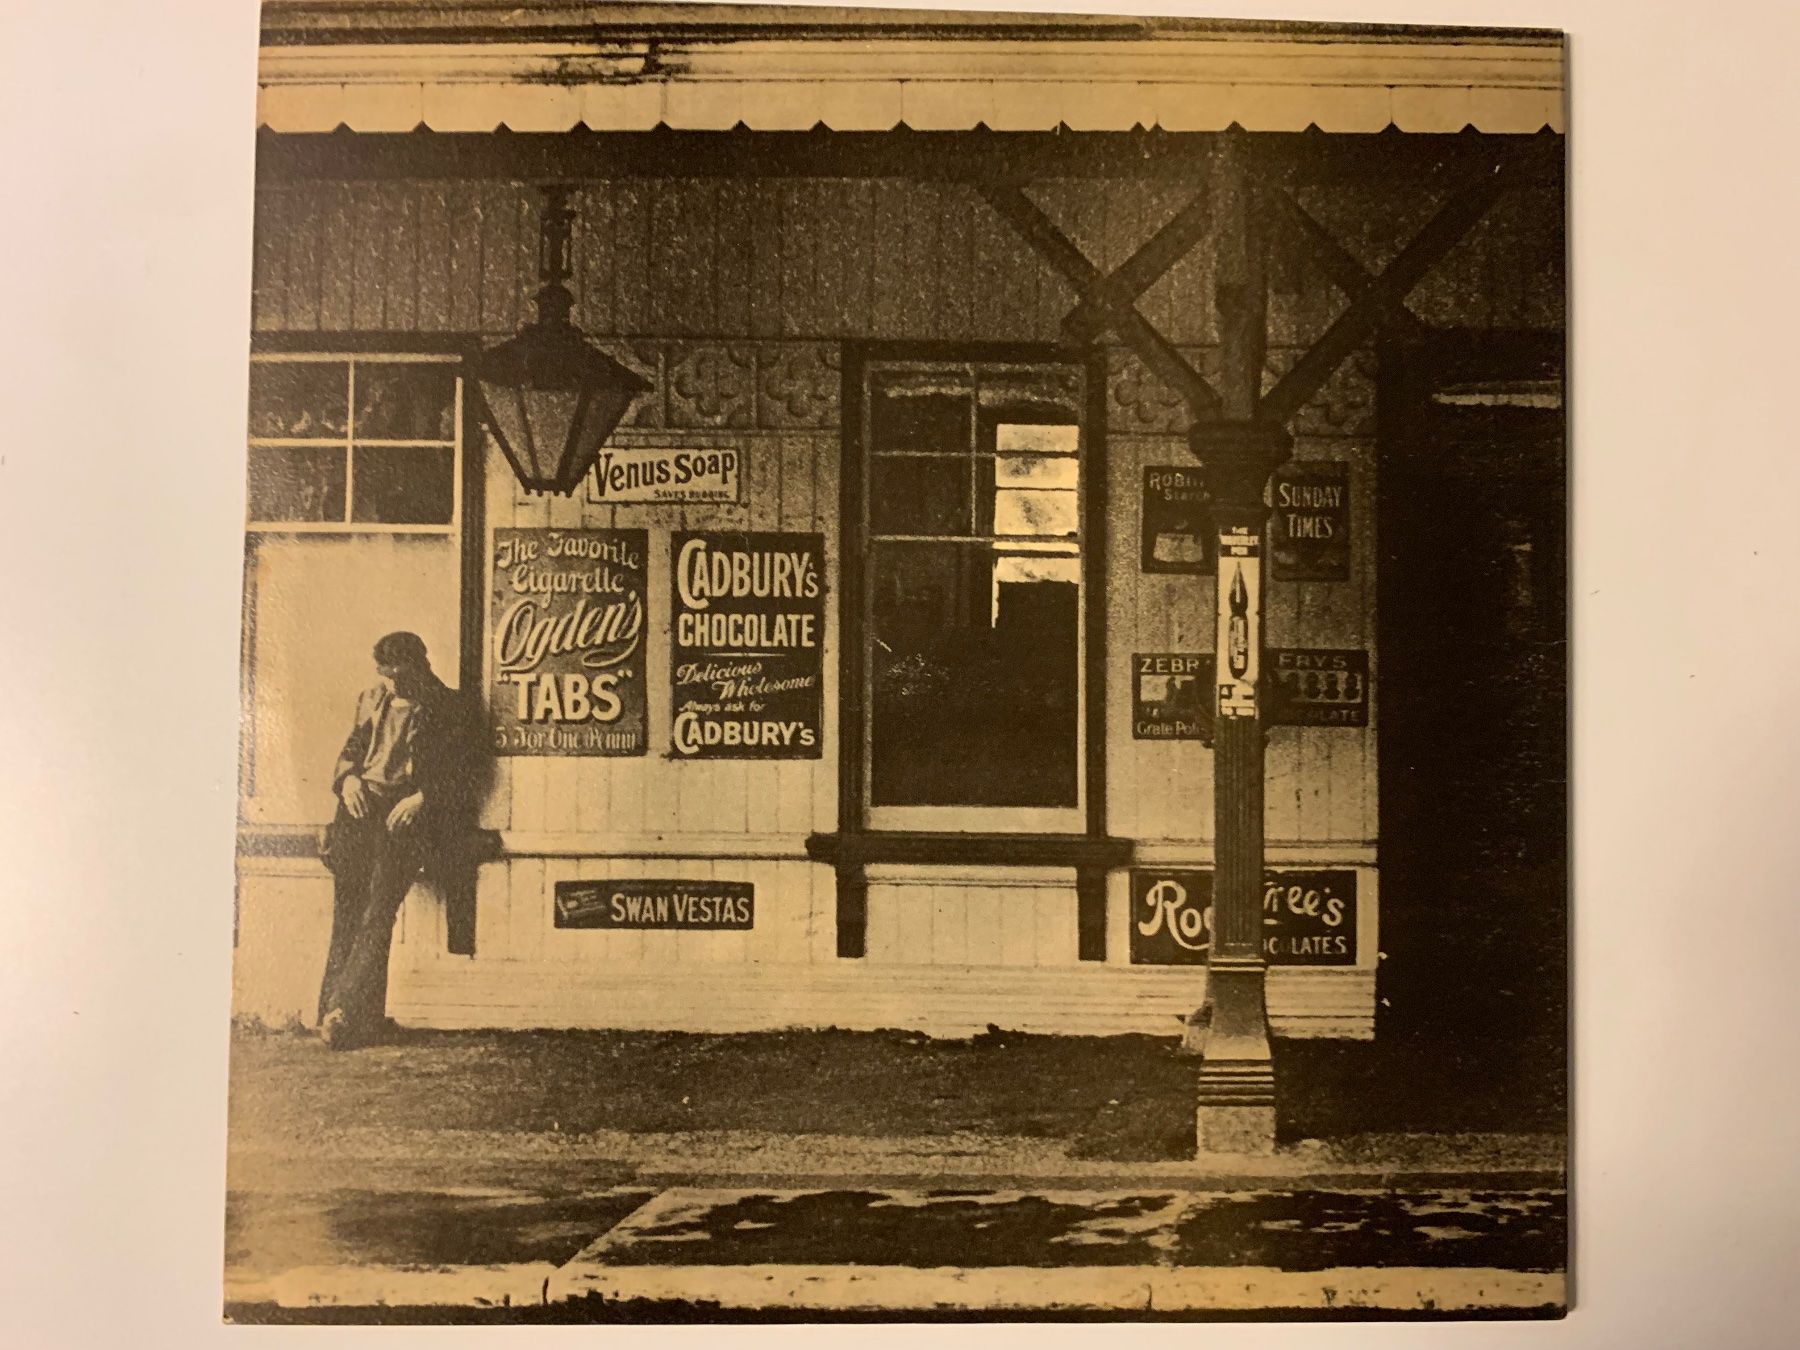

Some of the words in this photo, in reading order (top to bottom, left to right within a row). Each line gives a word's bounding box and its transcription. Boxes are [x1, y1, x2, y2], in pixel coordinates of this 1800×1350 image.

[594, 453, 671, 497] Venus
[674, 452, 735, 485] Soap
[1279, 482, 1342, 508] SUNDAY
[1286, 513, 1333, 538] TIMES
[498, 537, 539, 569] The
[547, 532, 640, 570] Favorite
[512, 564, 625, 609] Cigarette
[494, 590, 643, 672] Ogden's
[678, 612, 816, 648] CHOCOLATE
[676, 661, 763, 685] Delicious
[711, 675, 817, 701] Wholesome
[724, 700, 745, 713] ask
[749, 699, 767, 713] for
[610, 892, 669, 923] SWAN
[672, 893, 750, 924] VESTAS
